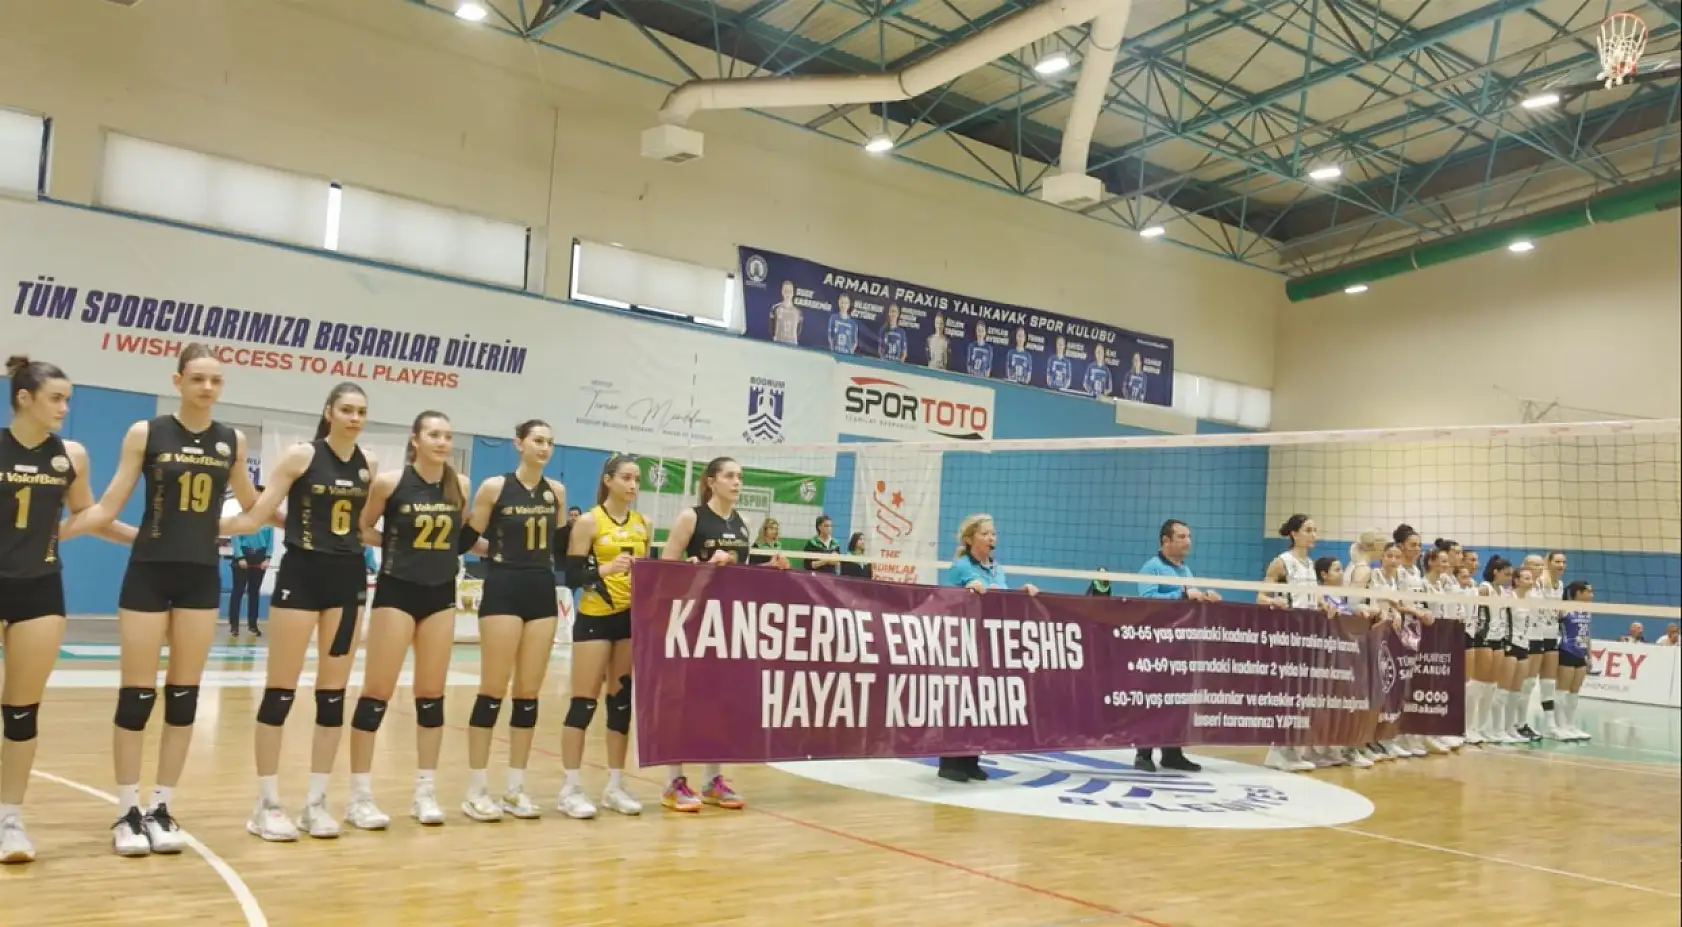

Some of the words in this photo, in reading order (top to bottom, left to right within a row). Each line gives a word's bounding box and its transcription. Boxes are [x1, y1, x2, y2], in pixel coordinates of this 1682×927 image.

[13, 274, 78, 320] TÜM
[81, 290, 311, 349] SPORCULARIMIZA
[313, 320, 441, 361] BAŞARILAR
[443, 333, 528, 374] DİLERİM
[823, 272, 890, 298] ARMADA
[894, 288, 949, 311] PRAXIS
[953, 299, 1027, 326] YALIKAVAK
[1029, 315, 1064, 334] SPOR
[102, 332, 110, 350] I
[115, 333, 182, 358] WISH
[298, 355, 328, 374] TO
[330, 359, 368, 378] ALL
[372, 364, 460, 389] PLAYERS
[15, 486, 31, 528] 1
[178, 471, 212, 513] 19
[331, 499, 352, 535] 6
[413, 514, 453, 550] 22
[524, 515, 547, 550] 11
[665, 599, 879, 664] KANSERDE
[881, 613, 979, 668] ERKEN
[1121, 625, 1152, 640] 30-65
[1135, 657, 1169, 673] 40-69
[761, 669, 876, 728] HAYAT
[885, 673, 1029, 728] KURTARIR
[1112, 690, 1143, 706] 50-70
